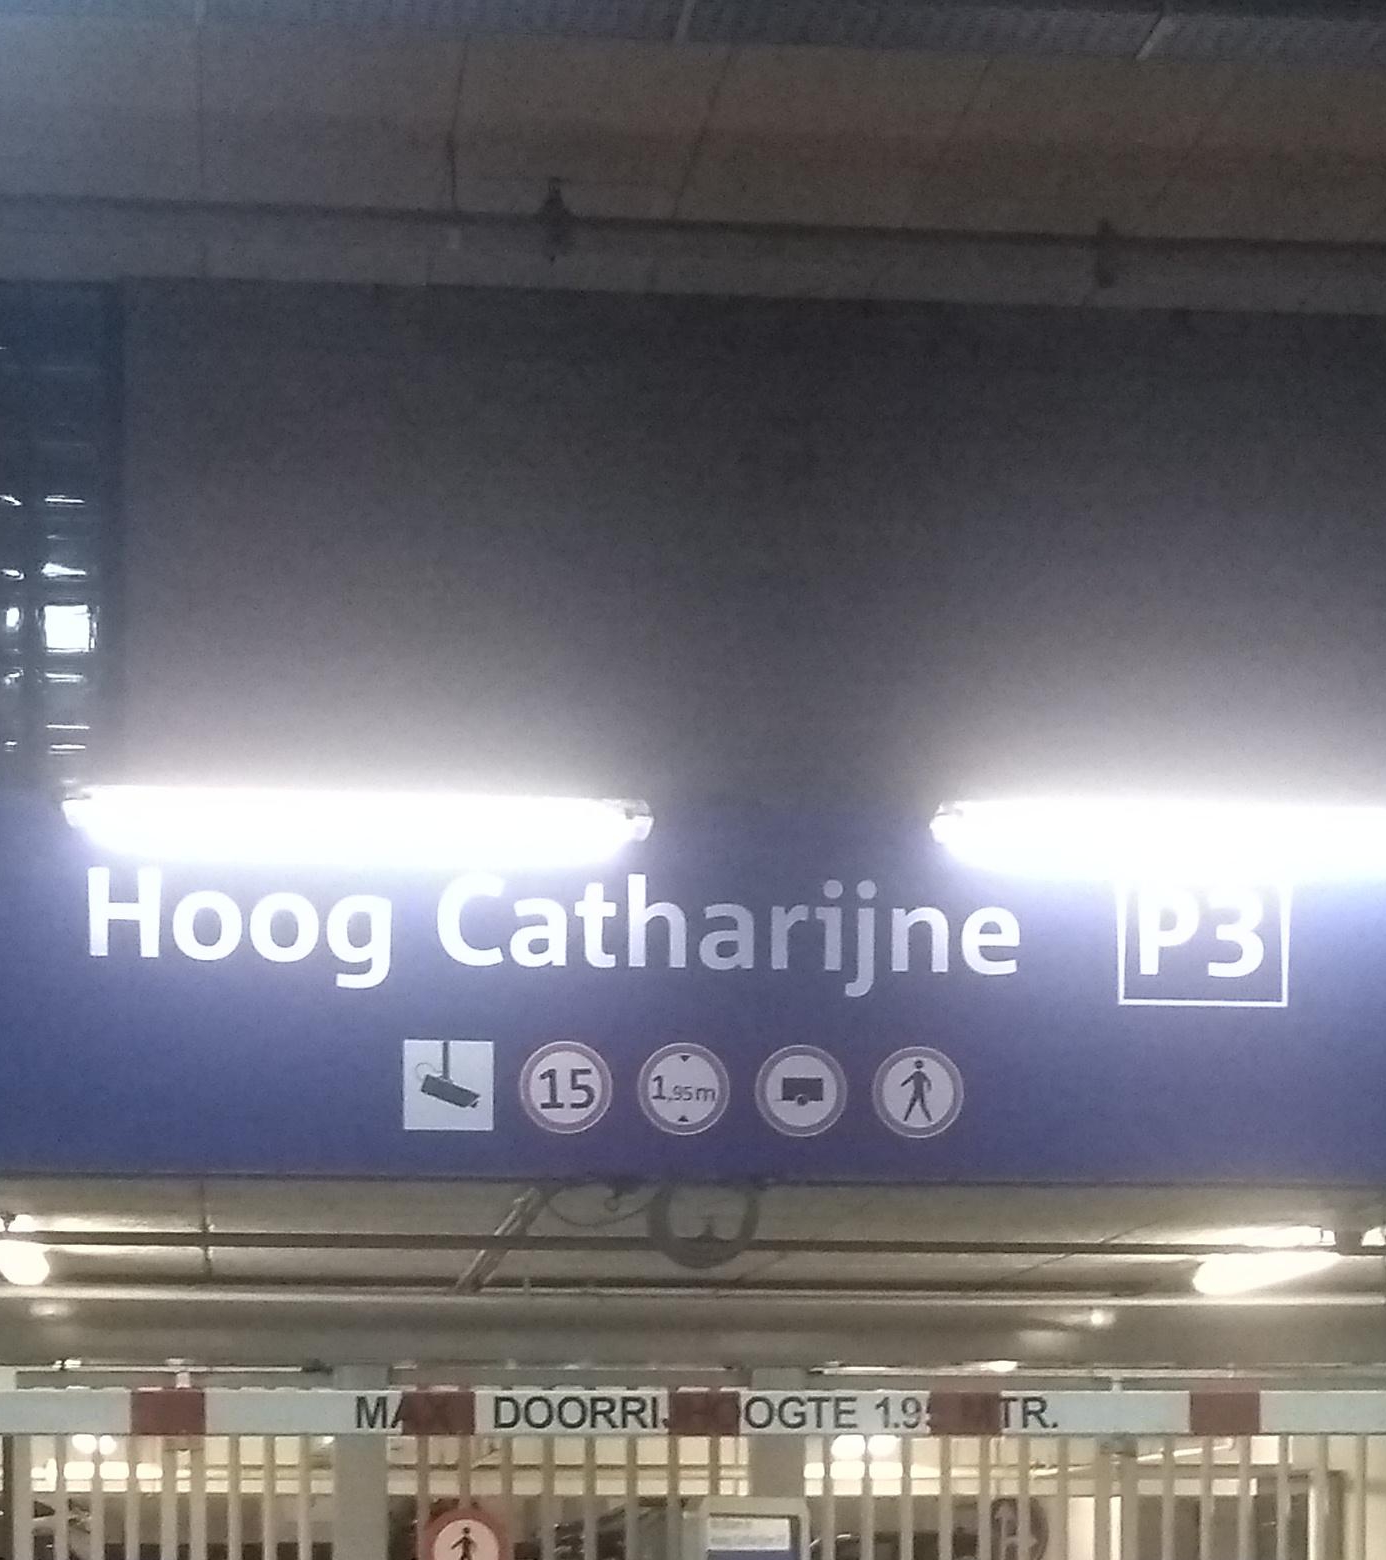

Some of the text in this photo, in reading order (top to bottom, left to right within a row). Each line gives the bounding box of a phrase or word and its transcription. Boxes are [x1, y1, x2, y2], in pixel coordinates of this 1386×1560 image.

[87, 866, 1021, 997] Hoog Catharijne
[1137, 884, 1265, 978] P3
[539, 1068, 596, 1109] 15
